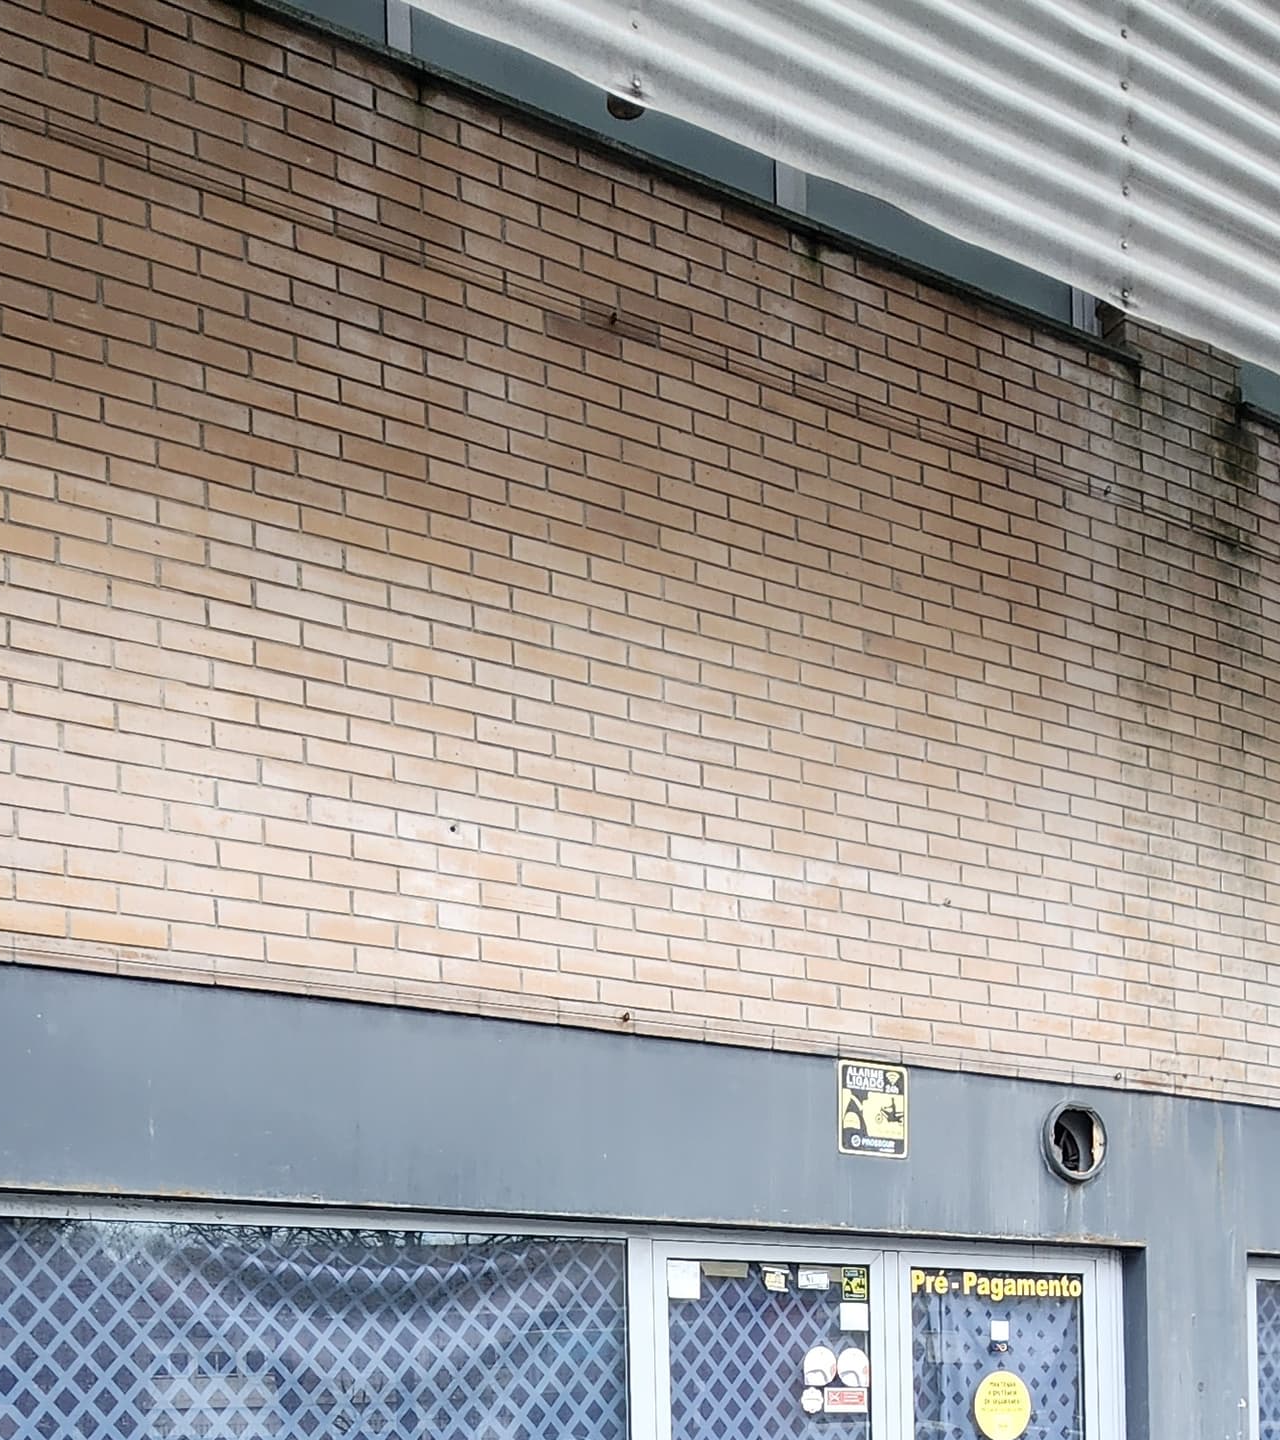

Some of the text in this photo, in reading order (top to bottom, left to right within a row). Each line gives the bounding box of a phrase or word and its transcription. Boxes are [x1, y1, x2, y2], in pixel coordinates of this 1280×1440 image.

[846, 1075, 884, 1090] LIGADO
[911, 1269, 949, 1294] Pré
[962, 1271, 1082, 1302] Pagamento
